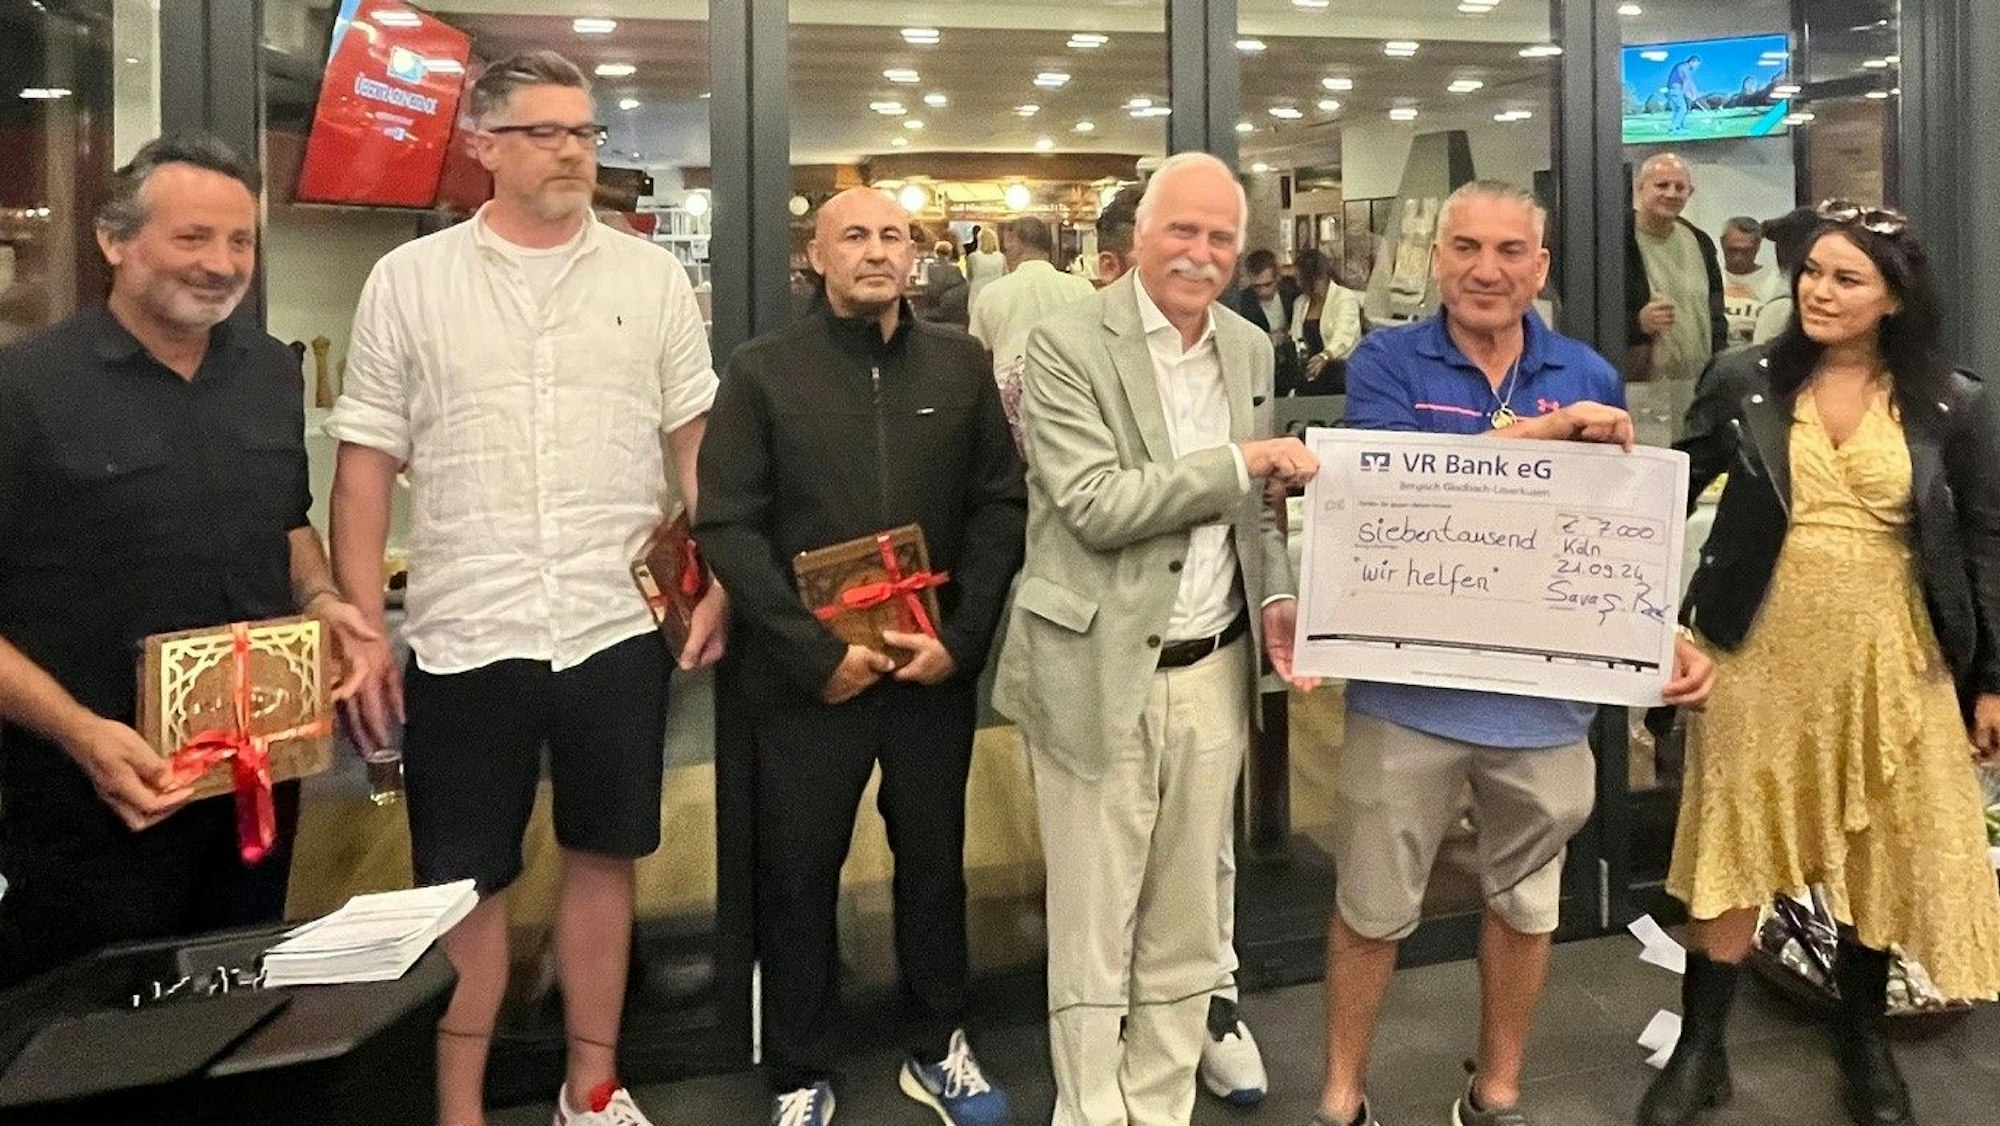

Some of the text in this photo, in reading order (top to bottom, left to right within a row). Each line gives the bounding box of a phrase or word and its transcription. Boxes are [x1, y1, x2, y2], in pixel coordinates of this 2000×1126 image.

[1403, 452, 1552, 480] VR Bank eG
[1358, 515, 1537, 550] siebentausend
